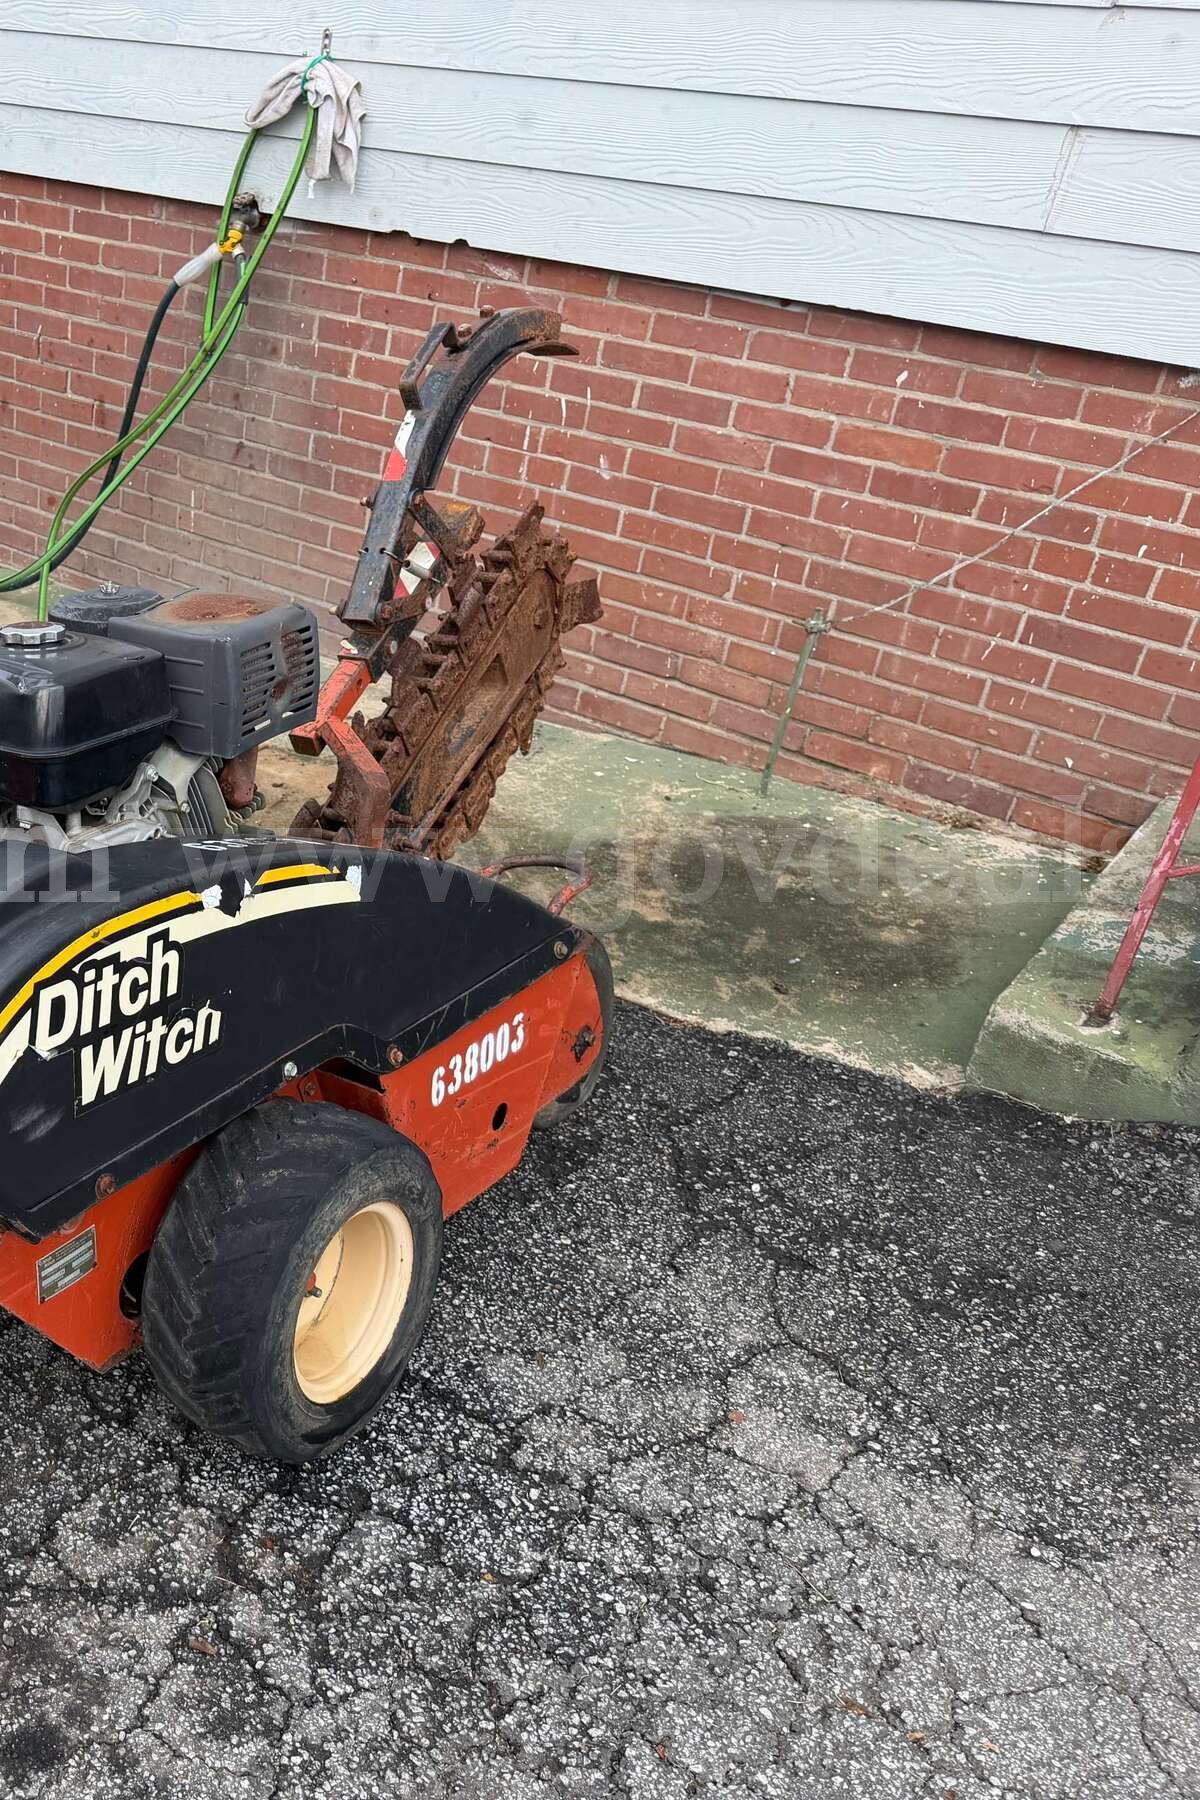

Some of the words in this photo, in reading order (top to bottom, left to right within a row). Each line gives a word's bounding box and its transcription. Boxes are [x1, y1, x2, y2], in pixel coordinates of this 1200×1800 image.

[35, 939, 180, 1053] Ditch
[80, 1000, 223, 1107] Witch
[431, 1012, 525, 1107] 638003
